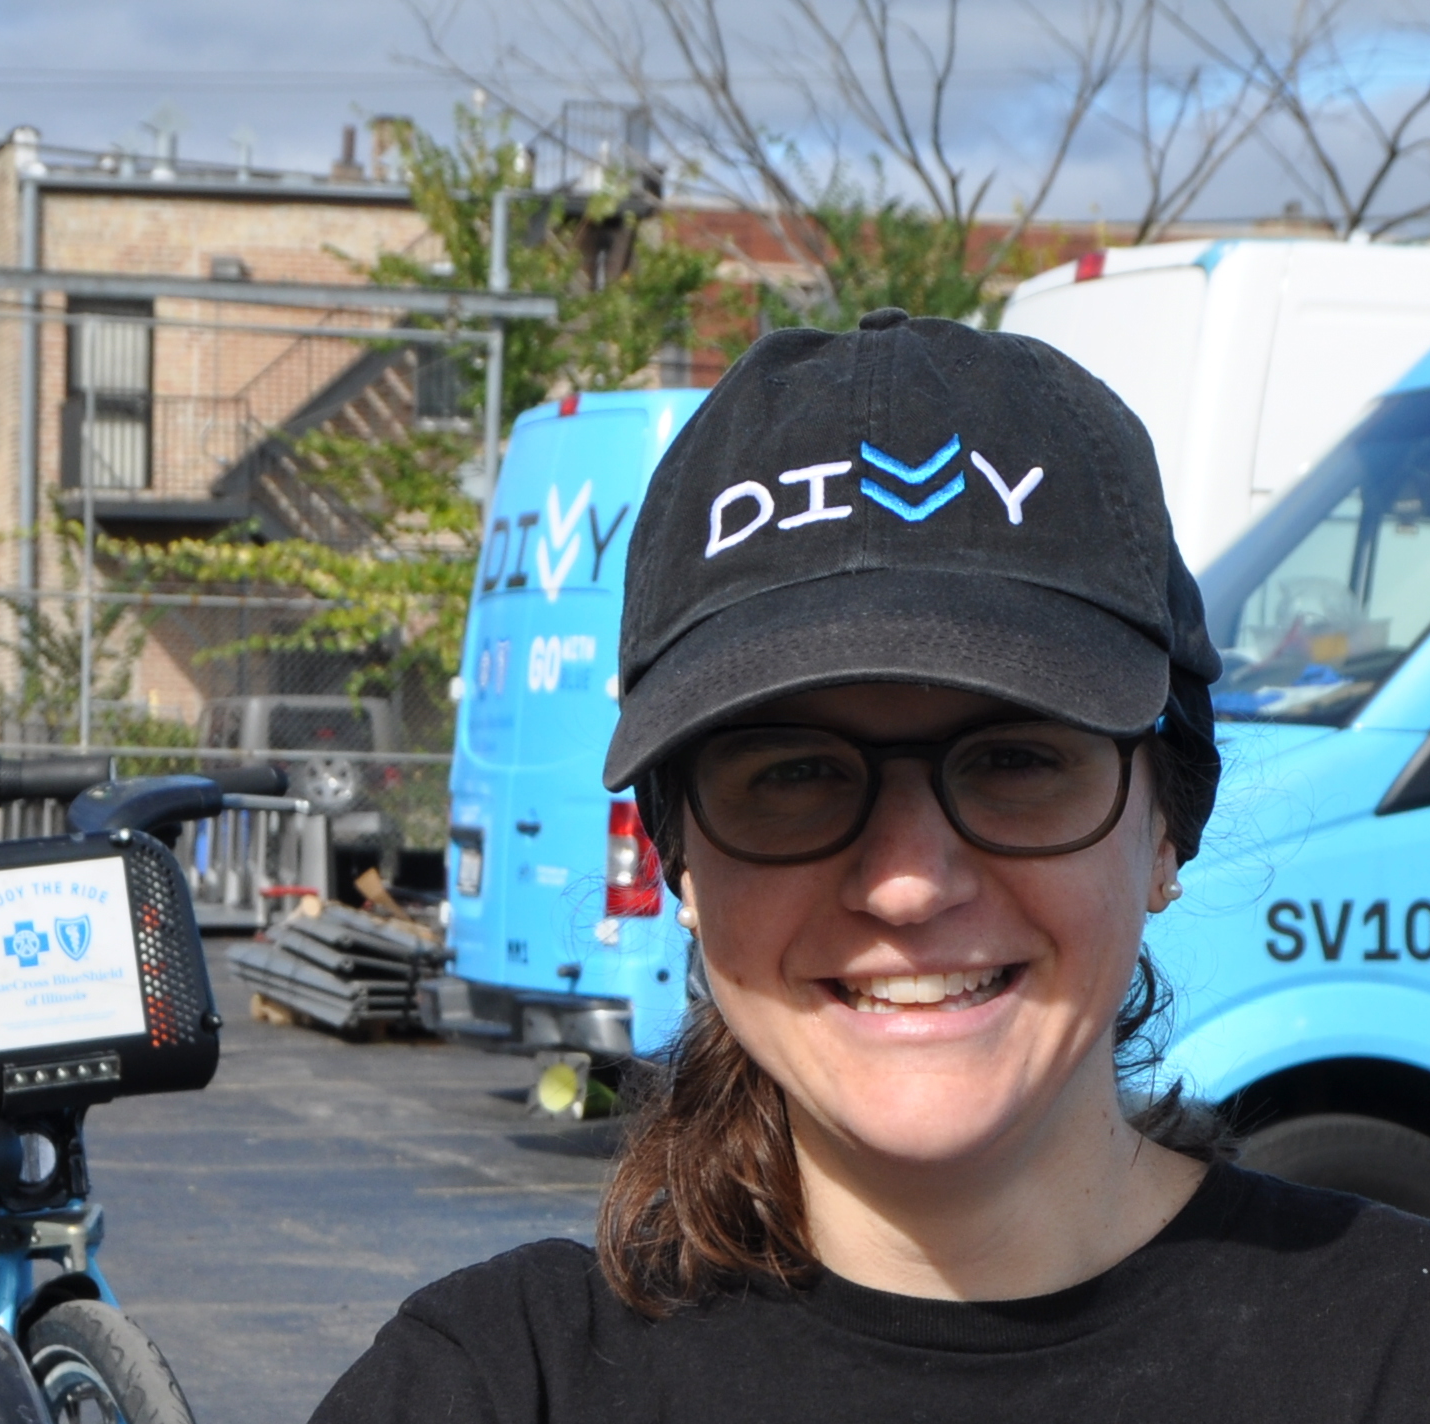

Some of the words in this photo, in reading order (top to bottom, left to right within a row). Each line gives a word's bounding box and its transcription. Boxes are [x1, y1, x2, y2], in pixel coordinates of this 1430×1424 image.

[705, 433, 1044, 558] DIVVY
[32, 881, 63, 895] THE
[70, 882, 109, 904] RIDE
